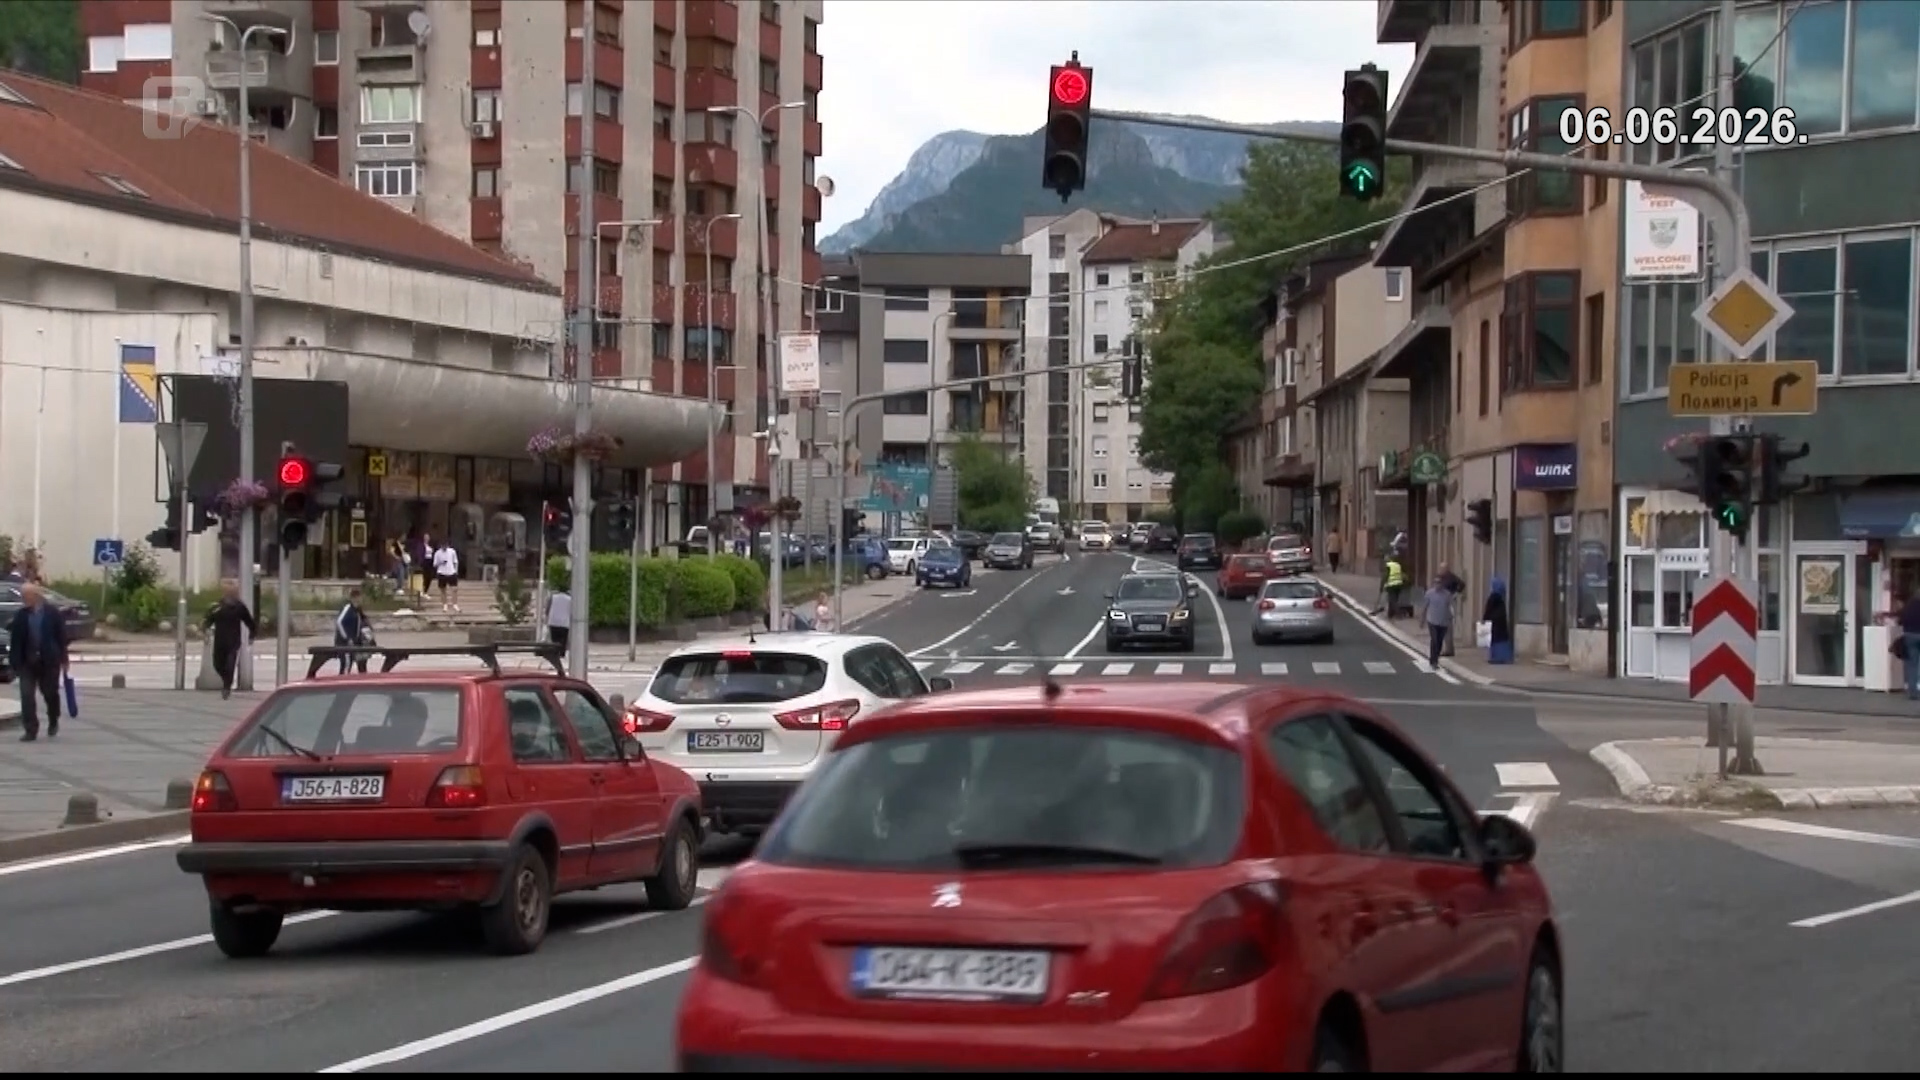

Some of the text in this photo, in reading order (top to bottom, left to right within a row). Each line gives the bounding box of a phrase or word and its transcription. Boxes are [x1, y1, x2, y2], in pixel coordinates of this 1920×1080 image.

[1650, 200, 1675, 208] FEST
[1634, 254, 1691, 265] WELCOME!
[1690, 371, 1748, 391] Policija
[1681, 392, 1758, 411] Полиција
[697, 733, 760, 748] E25-T-902
[294, 778, 380, 797] J56-A-828
